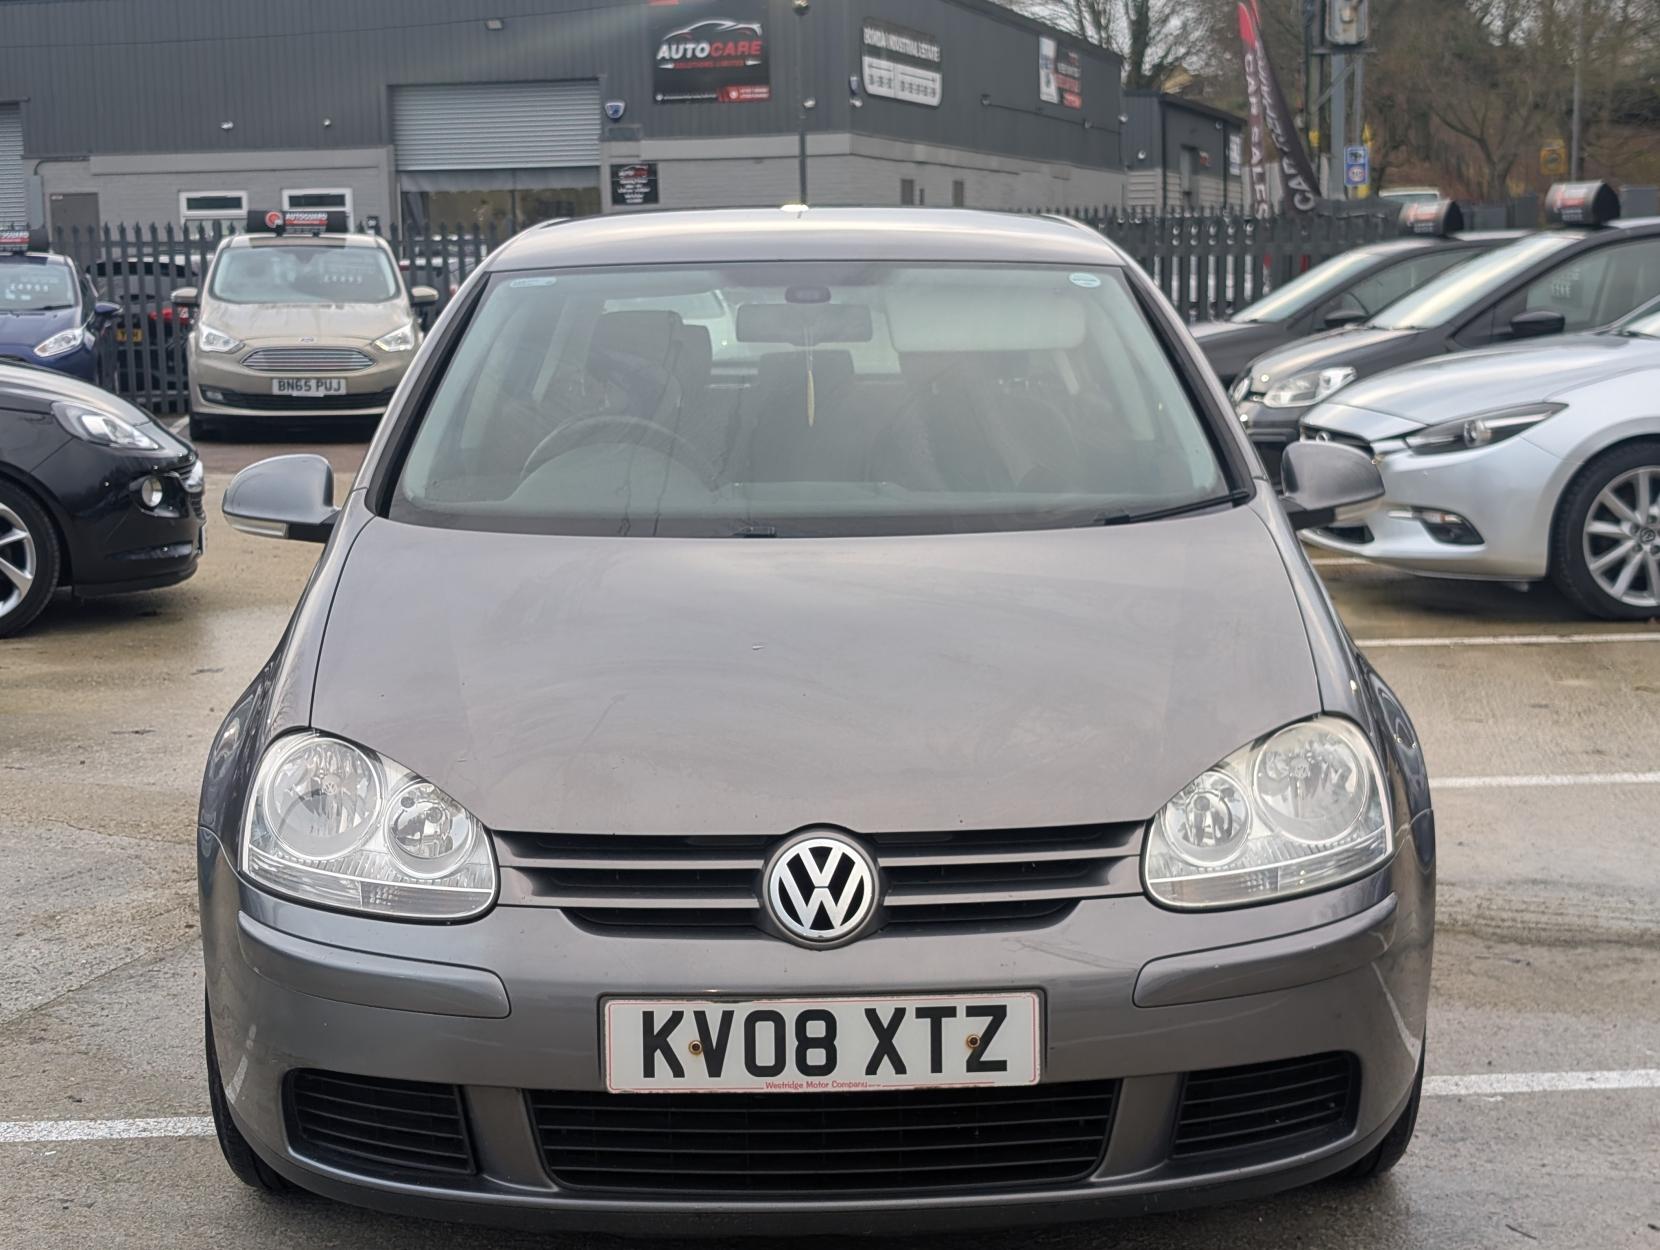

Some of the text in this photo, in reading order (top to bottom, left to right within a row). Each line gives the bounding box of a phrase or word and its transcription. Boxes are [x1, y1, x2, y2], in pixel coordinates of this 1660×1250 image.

[656, 40, 762, 60] AUTOCARE
[278, 380, 342, 392] BN65 PUJ
[642, 1004, 1008, 1079] KV08 XTZ
[765, 1081, 804, 1090] Westridge
[806, 1081, 829, 1089] Motor
[831, 1080, 868, 1089] Company
